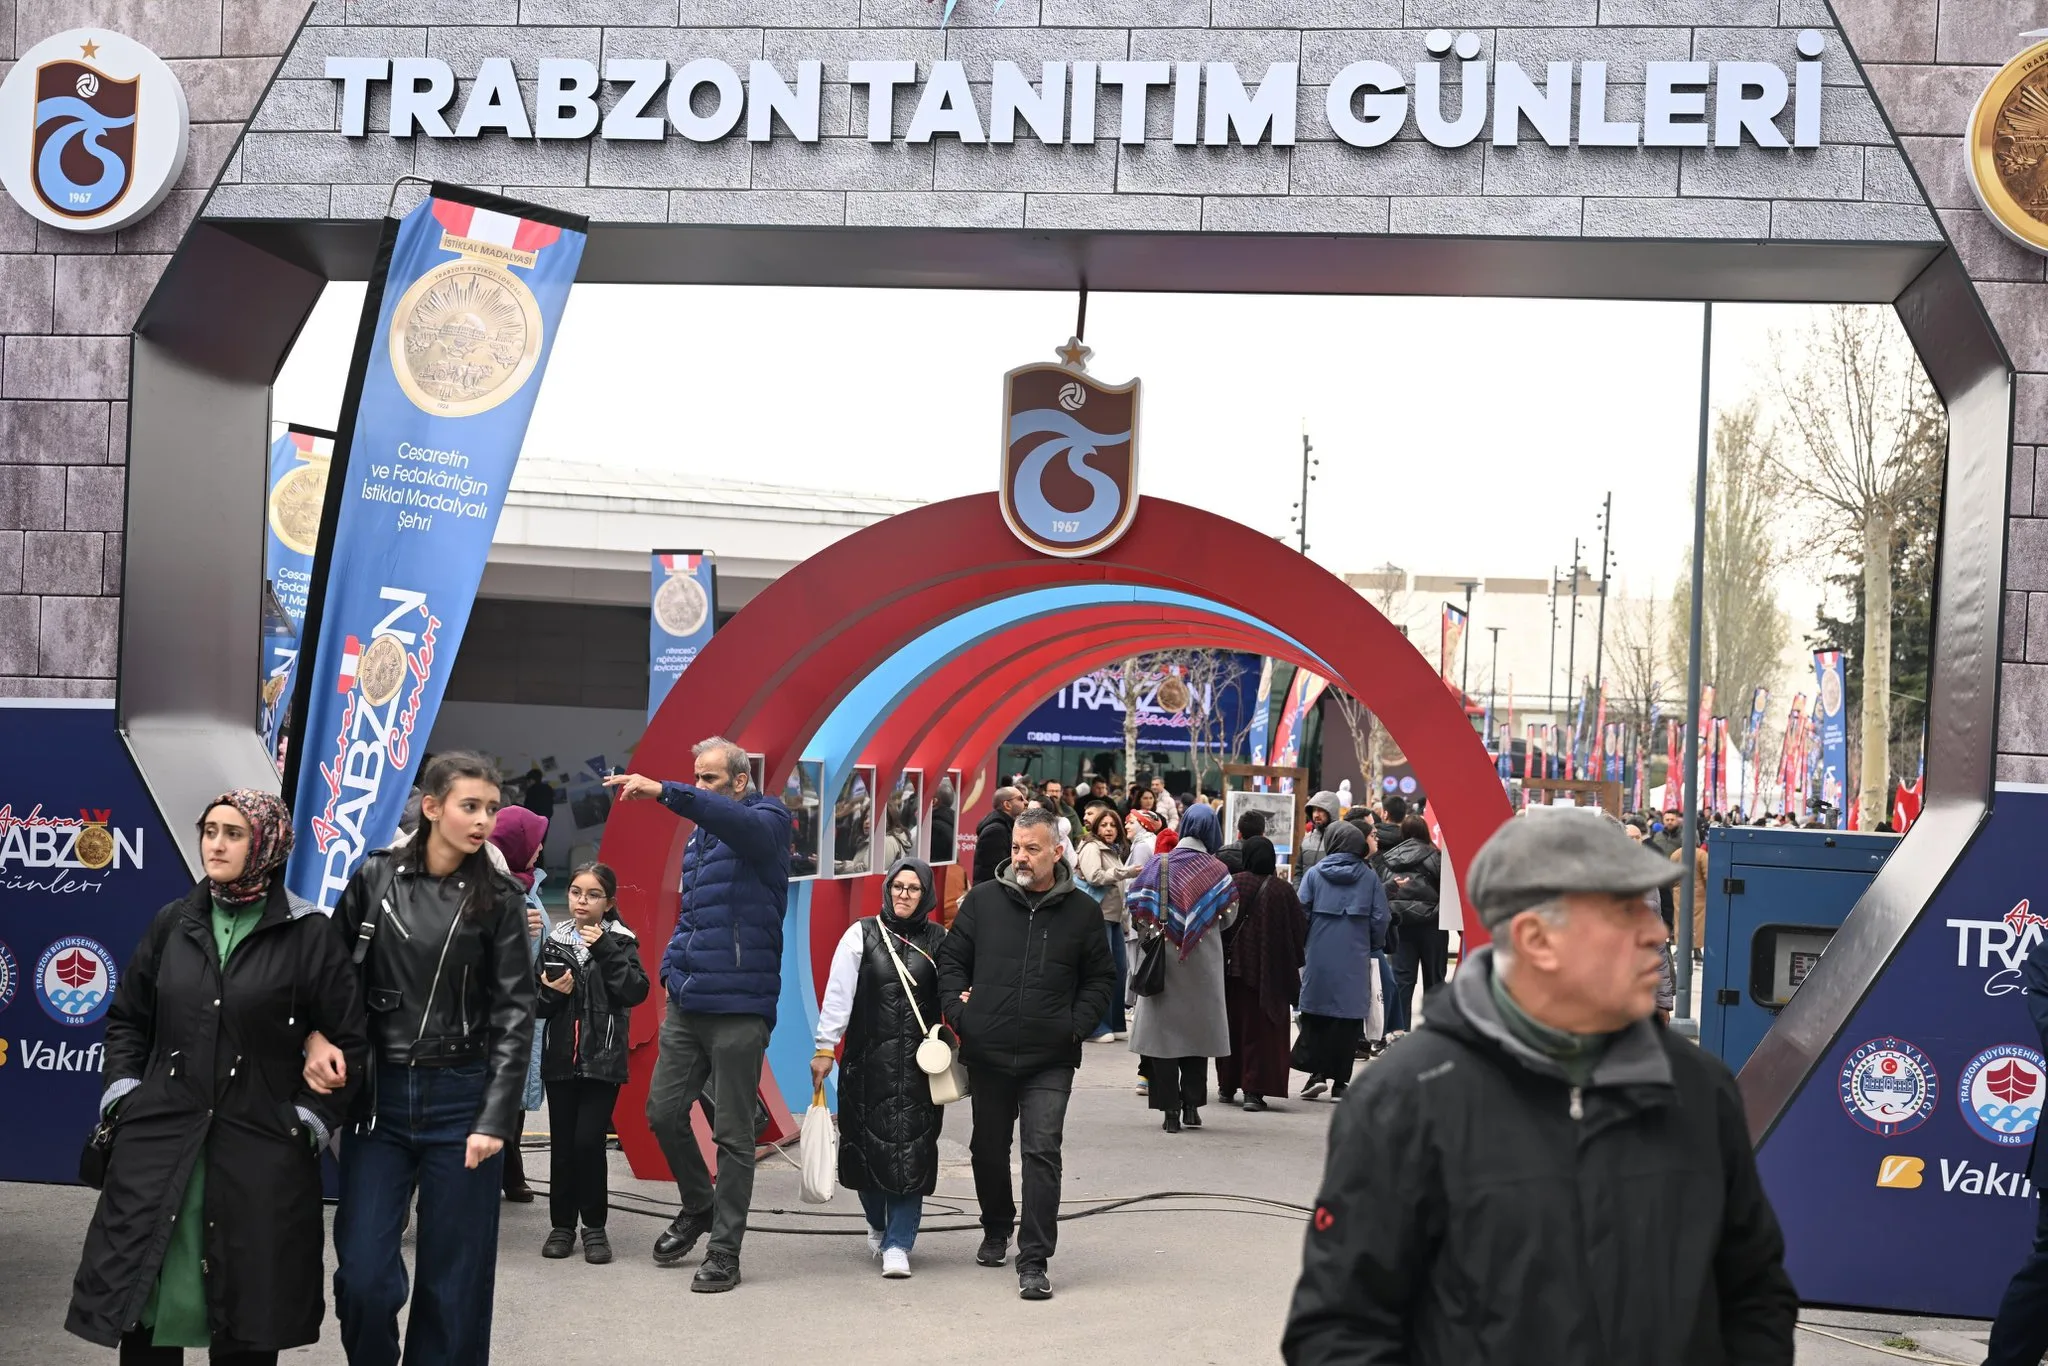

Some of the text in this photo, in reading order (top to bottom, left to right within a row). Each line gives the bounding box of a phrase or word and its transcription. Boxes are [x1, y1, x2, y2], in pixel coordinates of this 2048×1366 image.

[325, 29, 1824, 148] TRABZON TANITIM GÜNLERİ
[69, 192, 92, 204] 1967
[443, 236, 533, 266] İSTİKLAL MADALYASI
[434, 266, 465, 281] TRABZON
[397, 441, 470, 470] Cesaretin
[371, 463, 489, 498] ve Fedakârlığın
[361, 478, 488, 520] İstiklal Madalyalı
[397, 510, 433, 532] Şehri
[1052, 520, 1080, 533] 1967
[388, 604, 442, 770] Günleri
[311, 691, 356, 854] Ankara
[0, 803, 84, 838] Ankara
[2004, 898, 2048, 936] An
[35, 937, 118, 993] TRABZON BÜYÜKŞEHİR BELEDİYESİ
[66, 1015, 85, 1025] 1868
[1841, 1042, 1937, 1120] TRABZON VALİLİĞİ
[1960, 1045, 2040, 1104] TRABZON BÜYÜKŞEHİR
[1998, 1134, 2021, 1145] 1868
